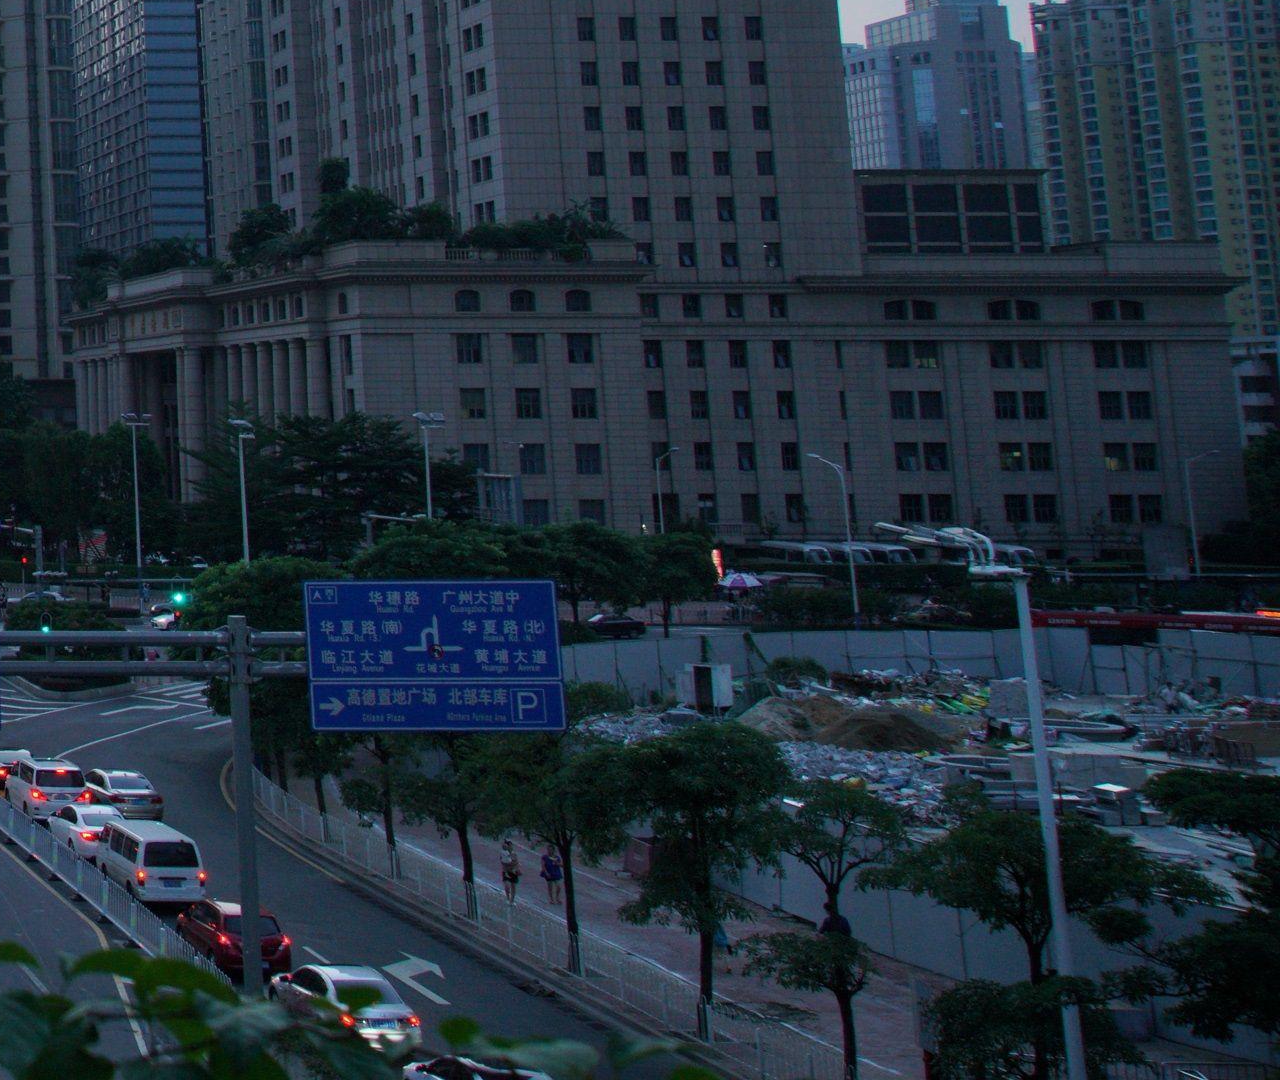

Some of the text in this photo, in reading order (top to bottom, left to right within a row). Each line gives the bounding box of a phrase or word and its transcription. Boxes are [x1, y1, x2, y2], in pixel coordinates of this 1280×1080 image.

[368, 590, 420, 605] 华穗路
[442, 590, 520, 605] 广州大道中
[321, 650, 394, 665] 临江大道
[474, 649, 548, 664] 黄埔大道
[347, 688, 509, 706] 高德置地广场 北部车库
[516, 692, 538, 720] P
